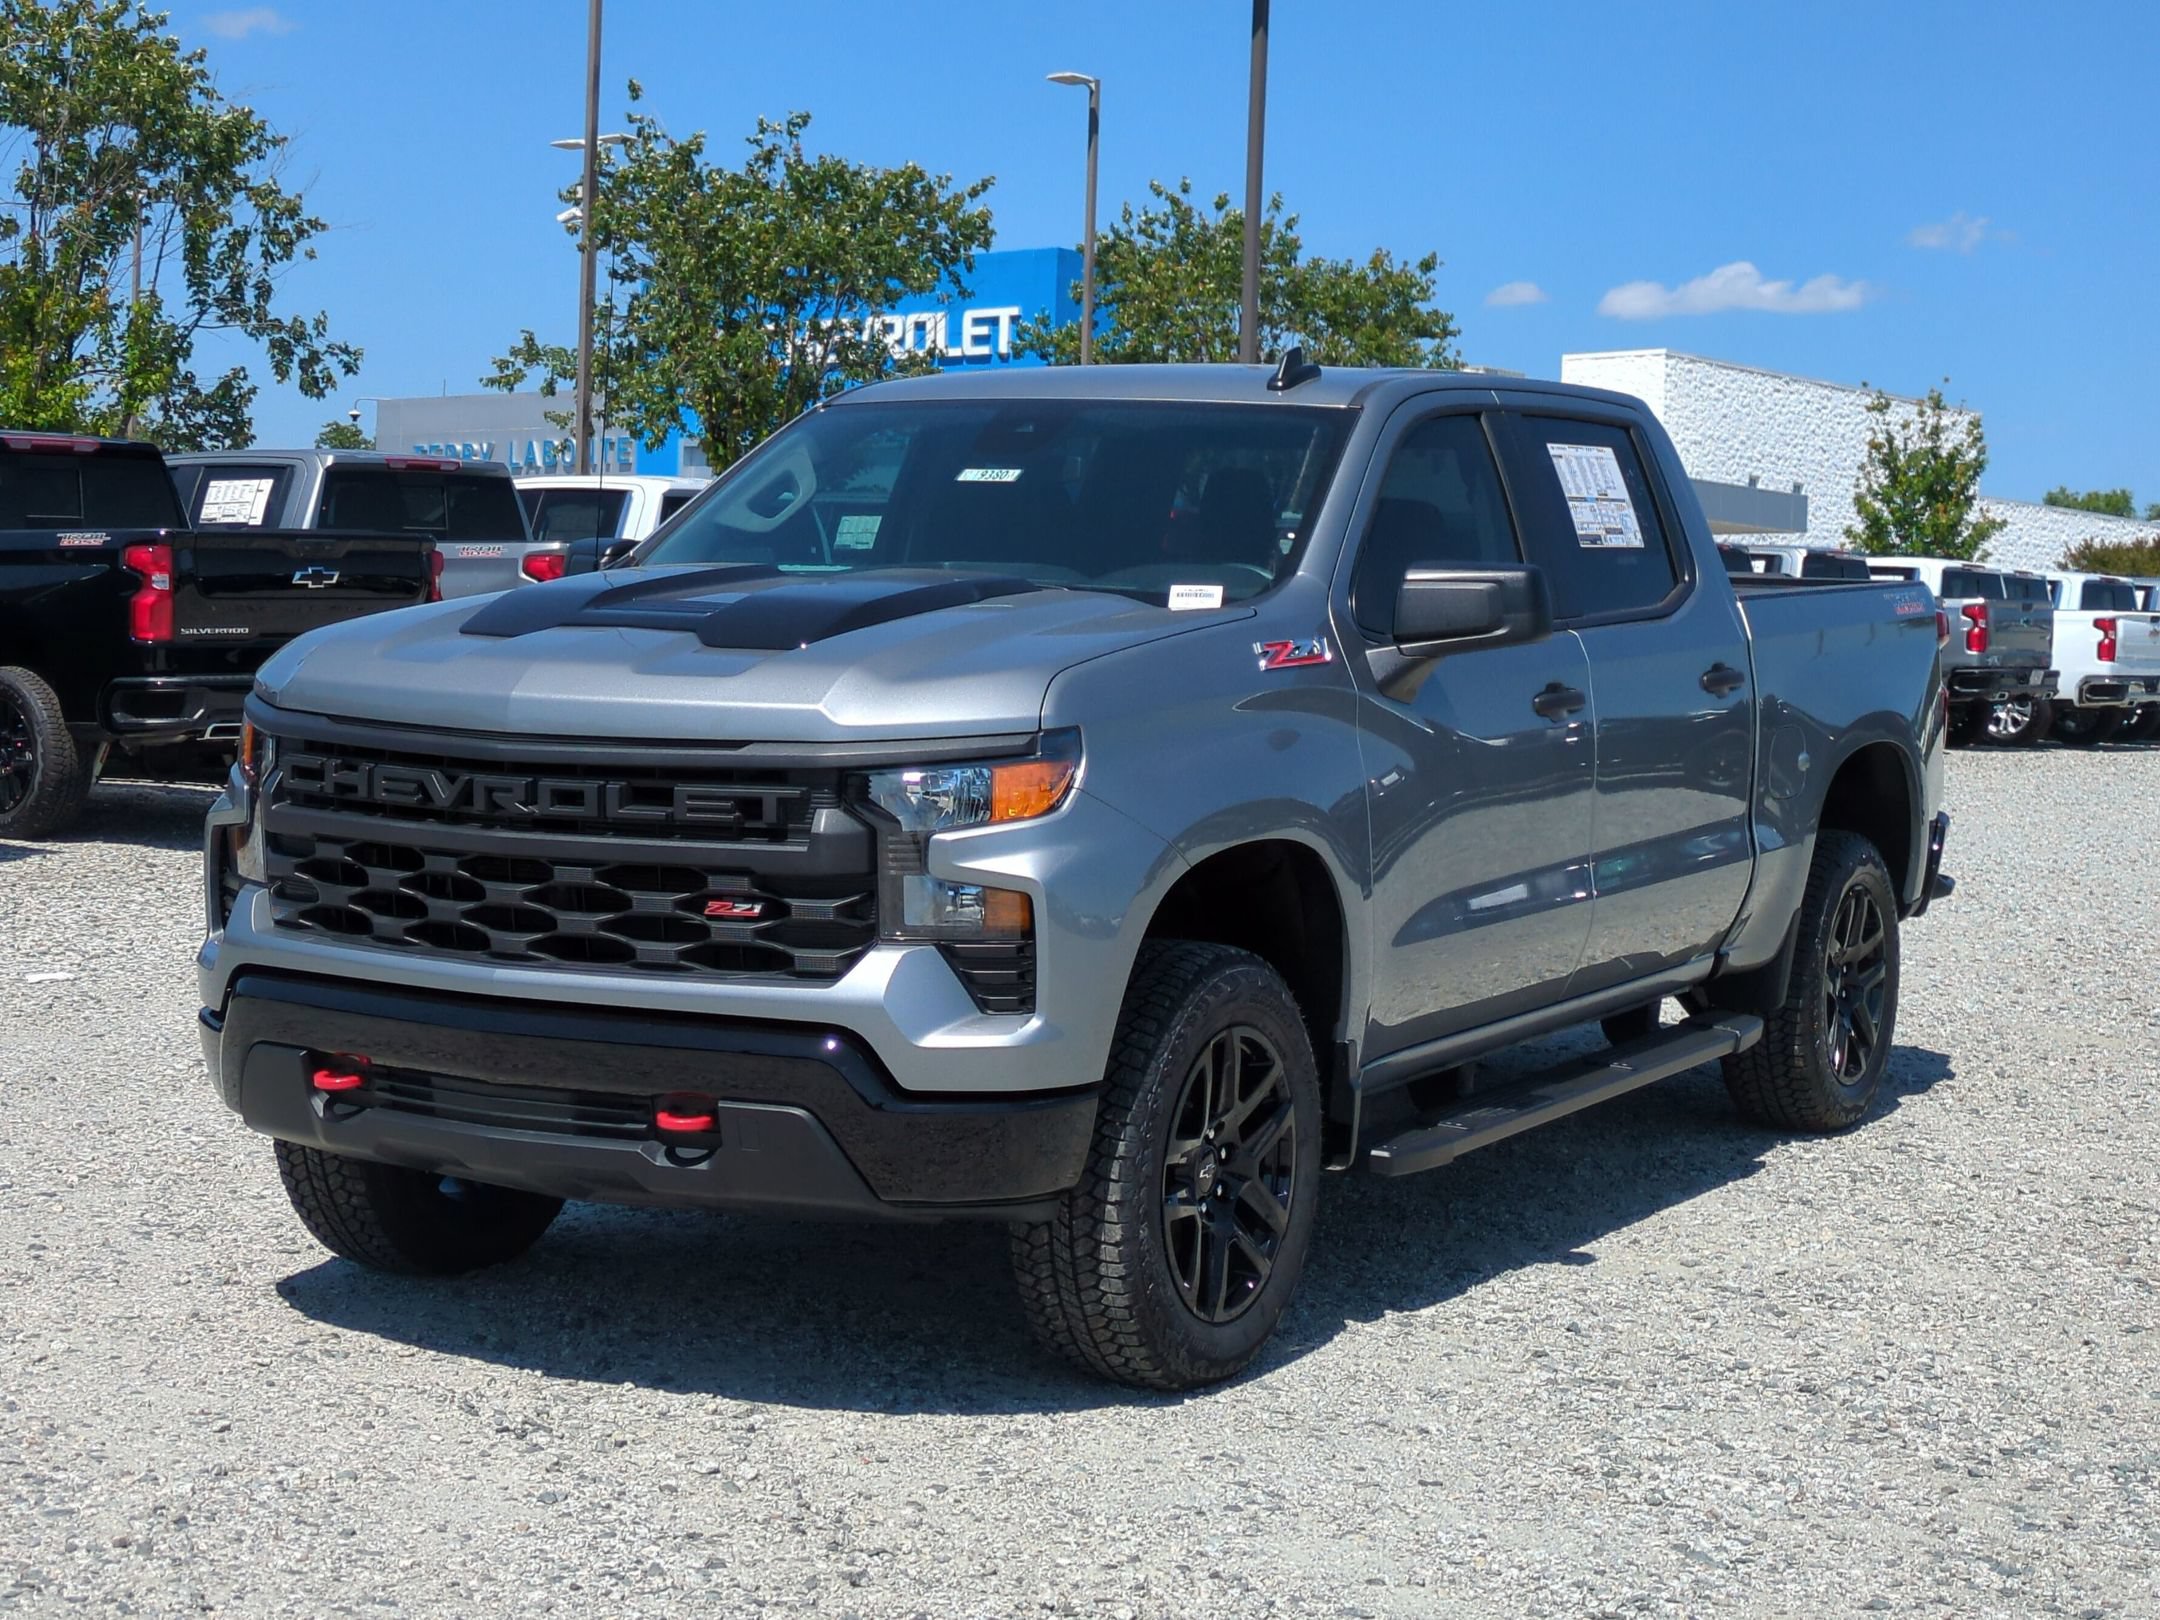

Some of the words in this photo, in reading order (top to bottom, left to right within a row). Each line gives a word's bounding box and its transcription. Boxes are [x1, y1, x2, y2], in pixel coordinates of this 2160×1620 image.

[762, 306, 1020, 367] ROLET
[280, 752, 811, 829] CHEVROLET
[704, 901, 764, 917] Z71
